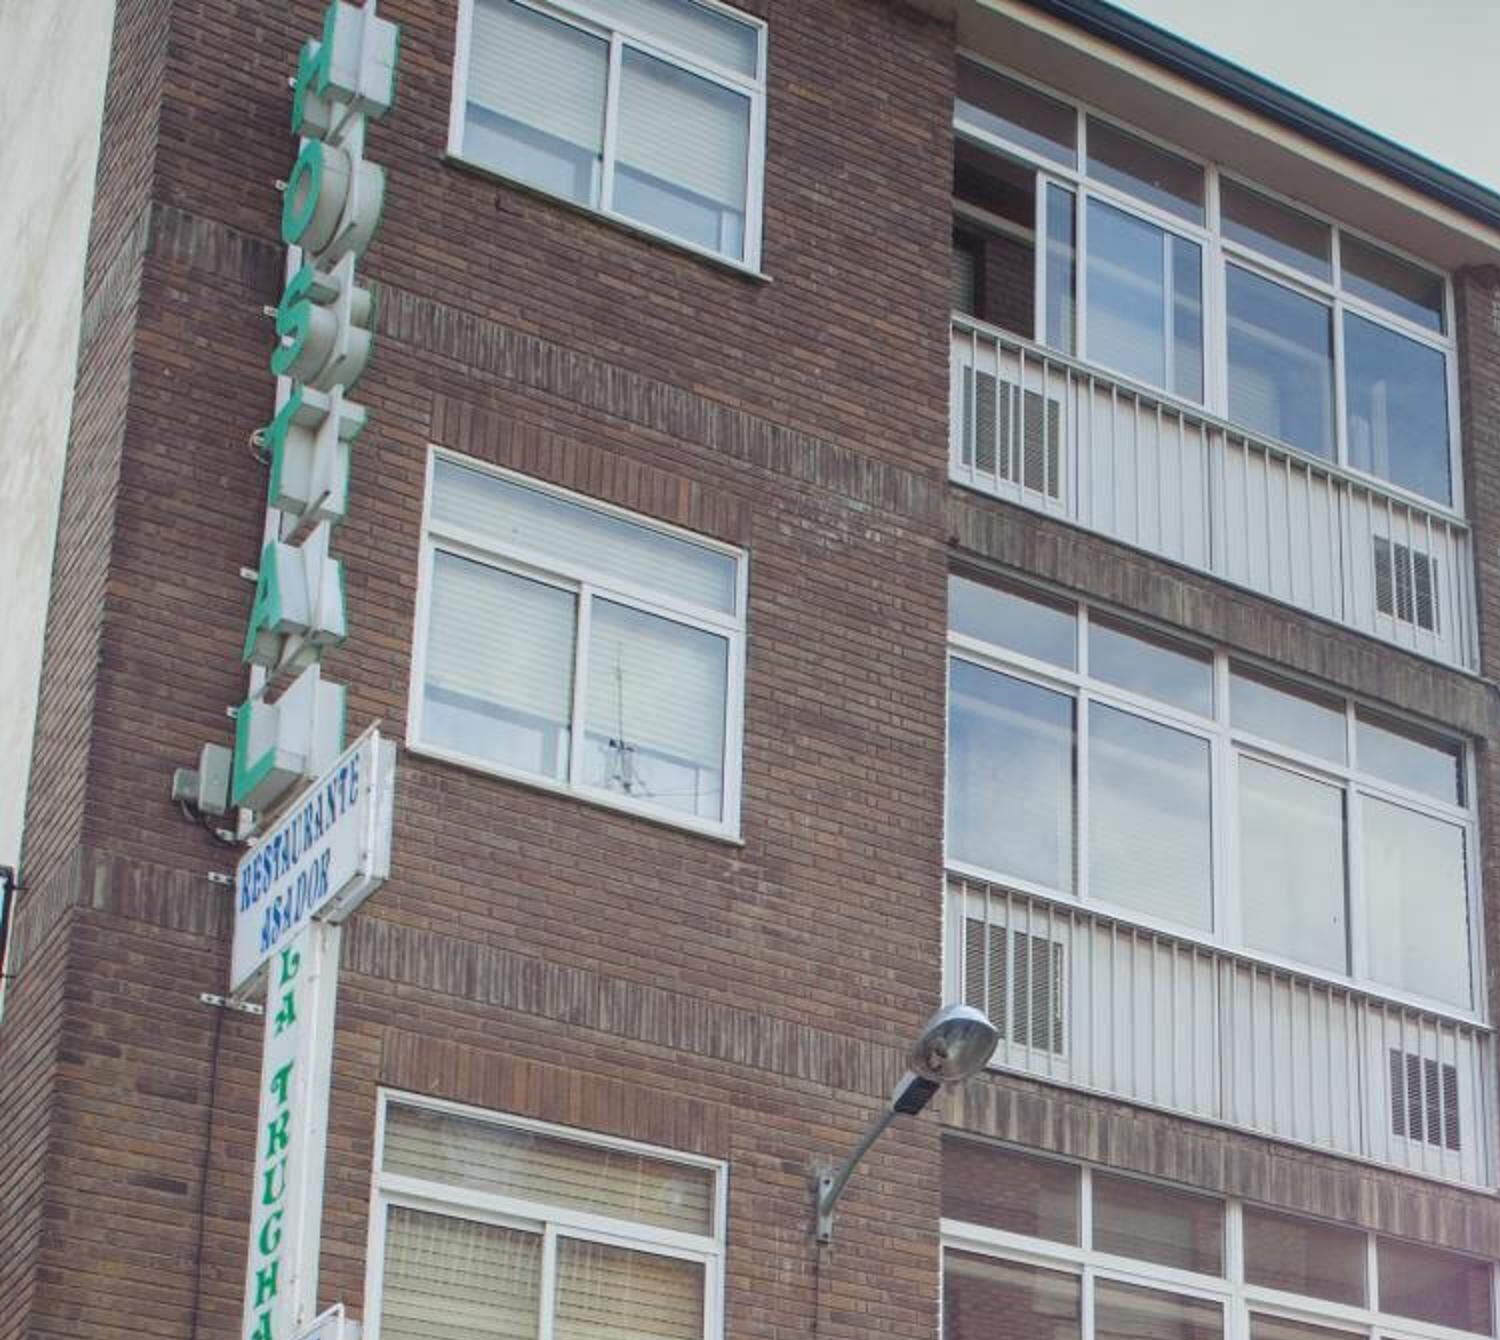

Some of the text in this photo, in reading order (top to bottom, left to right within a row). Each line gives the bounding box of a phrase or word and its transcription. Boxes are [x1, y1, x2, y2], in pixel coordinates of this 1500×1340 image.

[232, 0, 372, 808] HOSTAL
[239, 752, 360, 914] RESTAURANTE
[260, 847, 331, 953] ASADOR
[275, 946, 301, 1038] LA
